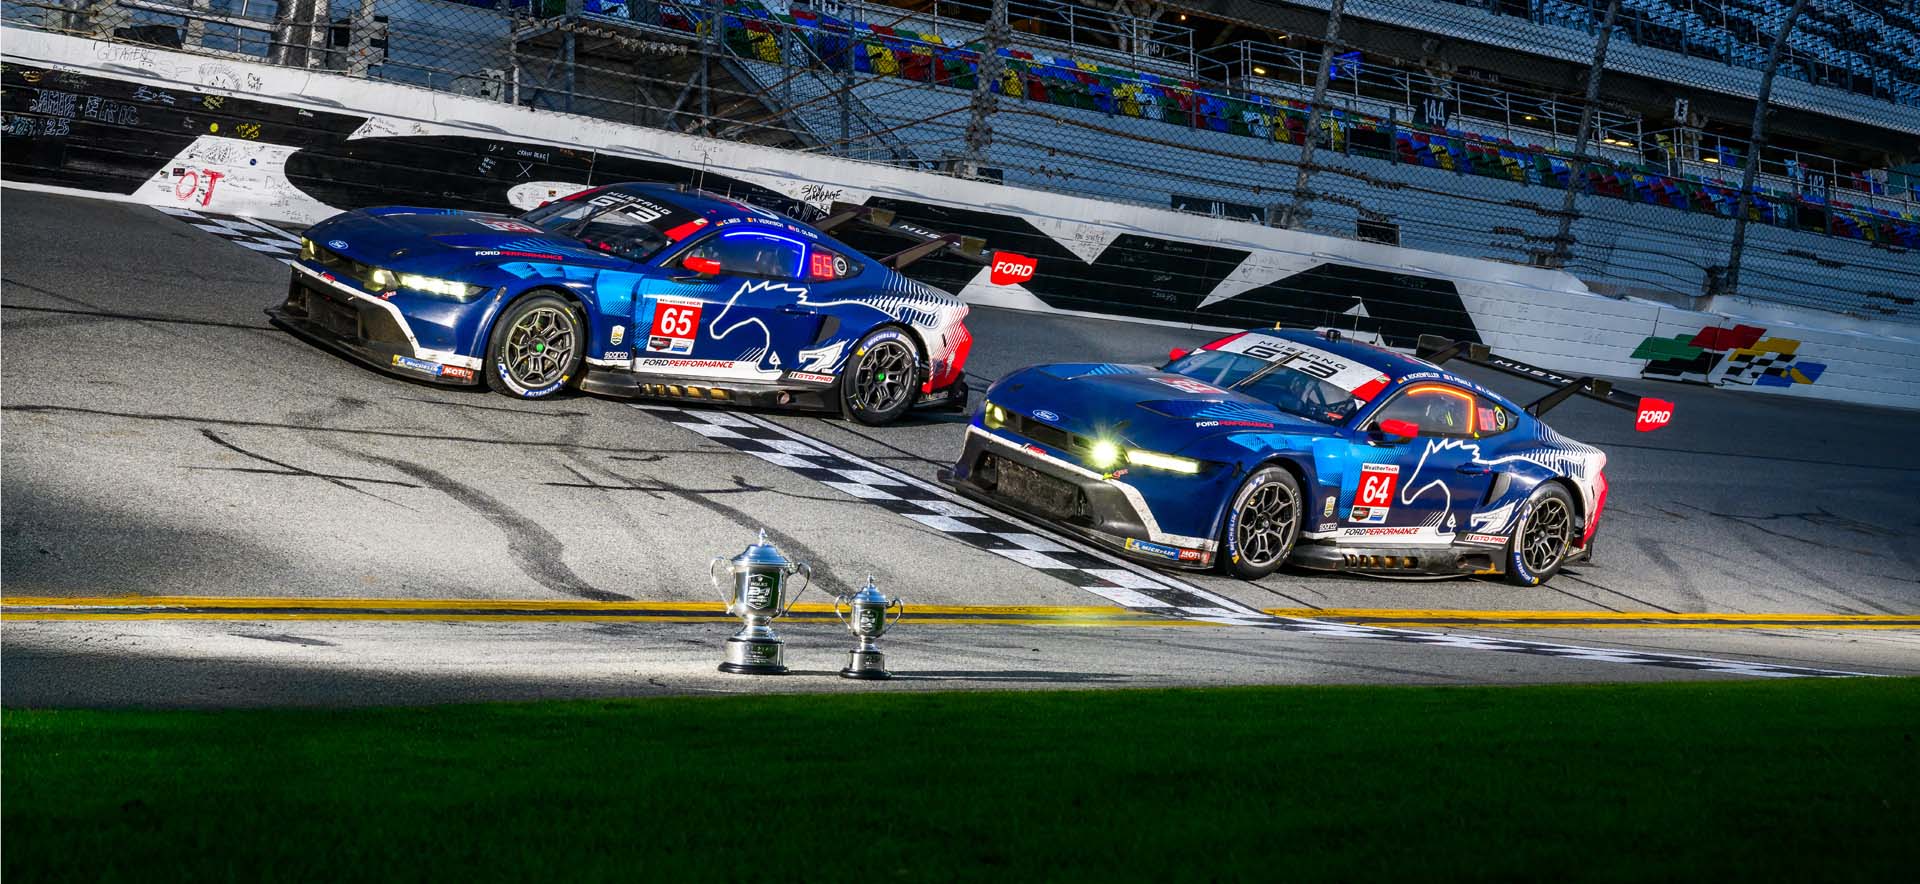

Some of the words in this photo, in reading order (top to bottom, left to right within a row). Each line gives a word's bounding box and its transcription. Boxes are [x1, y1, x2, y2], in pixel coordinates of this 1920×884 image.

[1425, 98, 1445, 127] 144
[607, 191, 672, 215] MUSTANG
[994, 261, 1033, 277] FORD
[660, 308, 694, 336] 65
[1242, 345, 1339, 379] GT3
[1259, 340, 1348, 370] MUSTANG
[1638, 411, 1671, 423] FORD
[1362, 475, 1390, 503] 64
